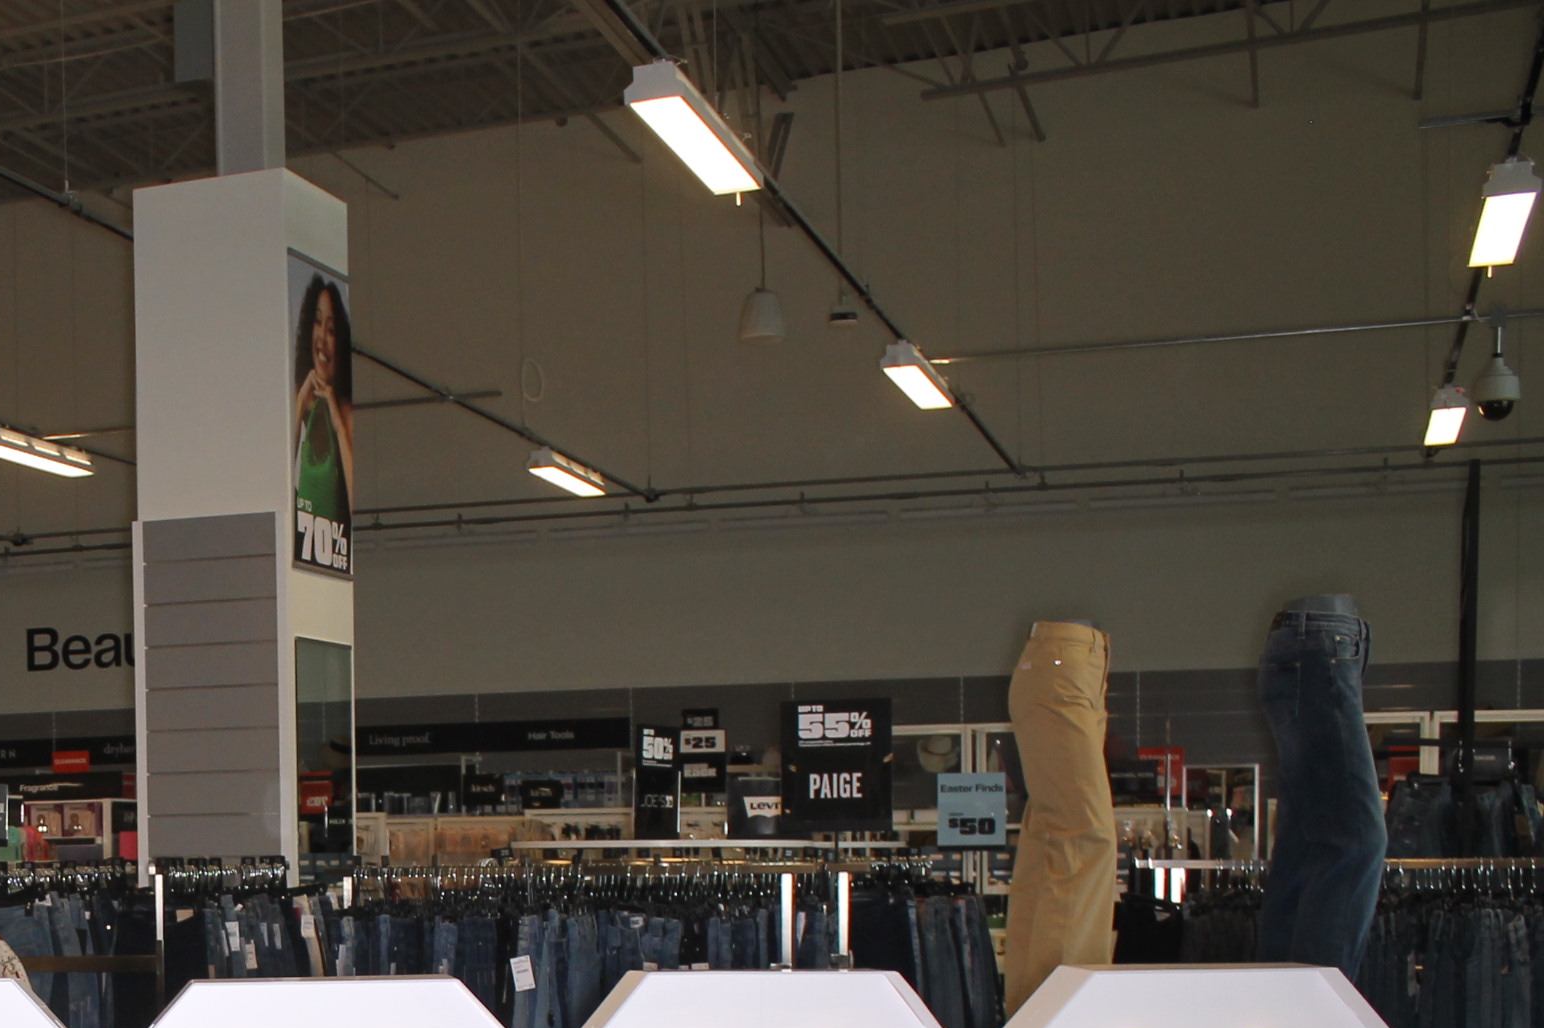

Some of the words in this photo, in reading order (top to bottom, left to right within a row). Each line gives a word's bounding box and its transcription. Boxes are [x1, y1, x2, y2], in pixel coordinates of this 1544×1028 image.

[297, 510, 348, 566] 70%
[332, 553, 348, 570] OFF
[797, 711, 872, 739] 55%
[684, 735, 717, 749] $25
[809, 772, 863, 799] PAIGE
[940, 784, 973, 793] Easter
[975, 783, 1003, 792] Finds
[948, 817, 996, 835] $50
